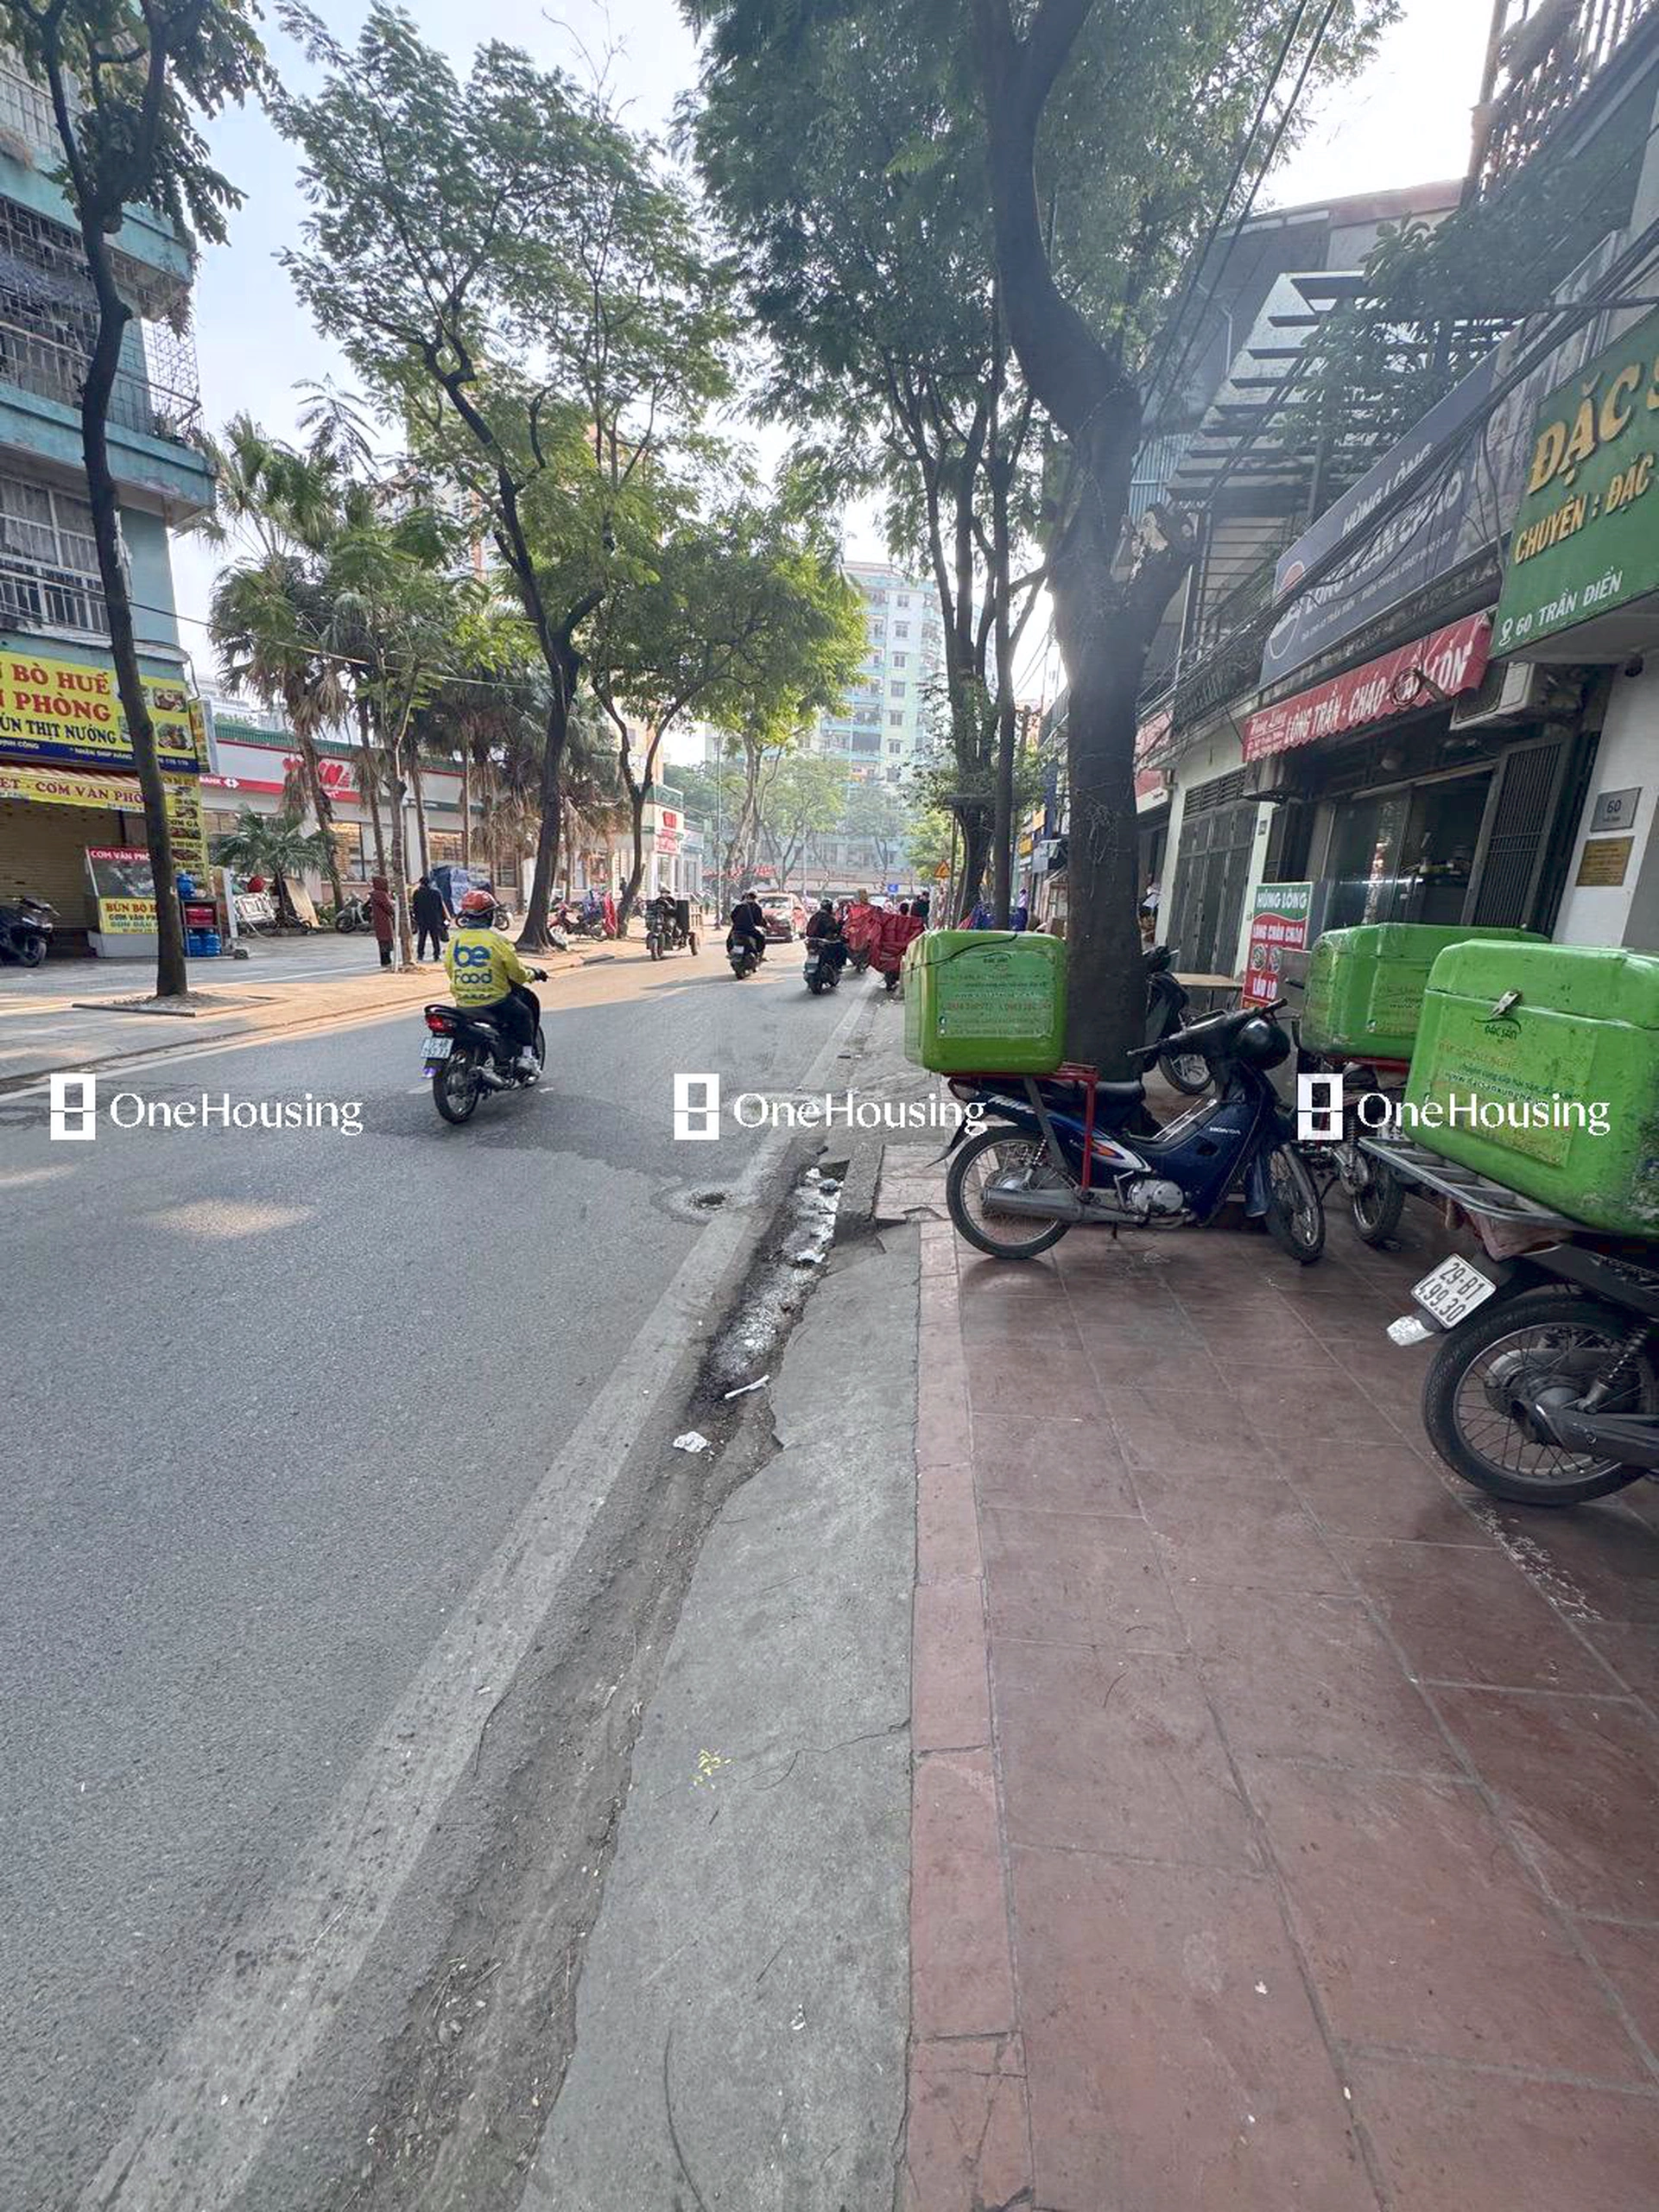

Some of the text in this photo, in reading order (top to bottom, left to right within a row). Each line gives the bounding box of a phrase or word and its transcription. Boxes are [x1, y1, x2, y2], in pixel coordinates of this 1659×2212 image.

[1527, 362, 1641, 496] ĐẶC
[1515, 493, 1587, 565] CHUYÊN
[1605, 453, 1655, 515] ĐẶC
[1515, 613, 1533, 637] 60
[1538, 588, 1578, 627] TRẦN
[11, 662, 48, 685] BÒ
[13, 691, 111, 722] PHÒNG
[25, 719, 61, 741] THỊT
[1607, 799, 1623, 813] 60
[453, 940, 492, 967] be
[454, 969, 492, 985] Food
[1209, 1125, 1241, 1135] HONDA
[1440, 1261, 1486, 1302] 29-B1
[1418, 1278, 1466, 1323] 499.30
